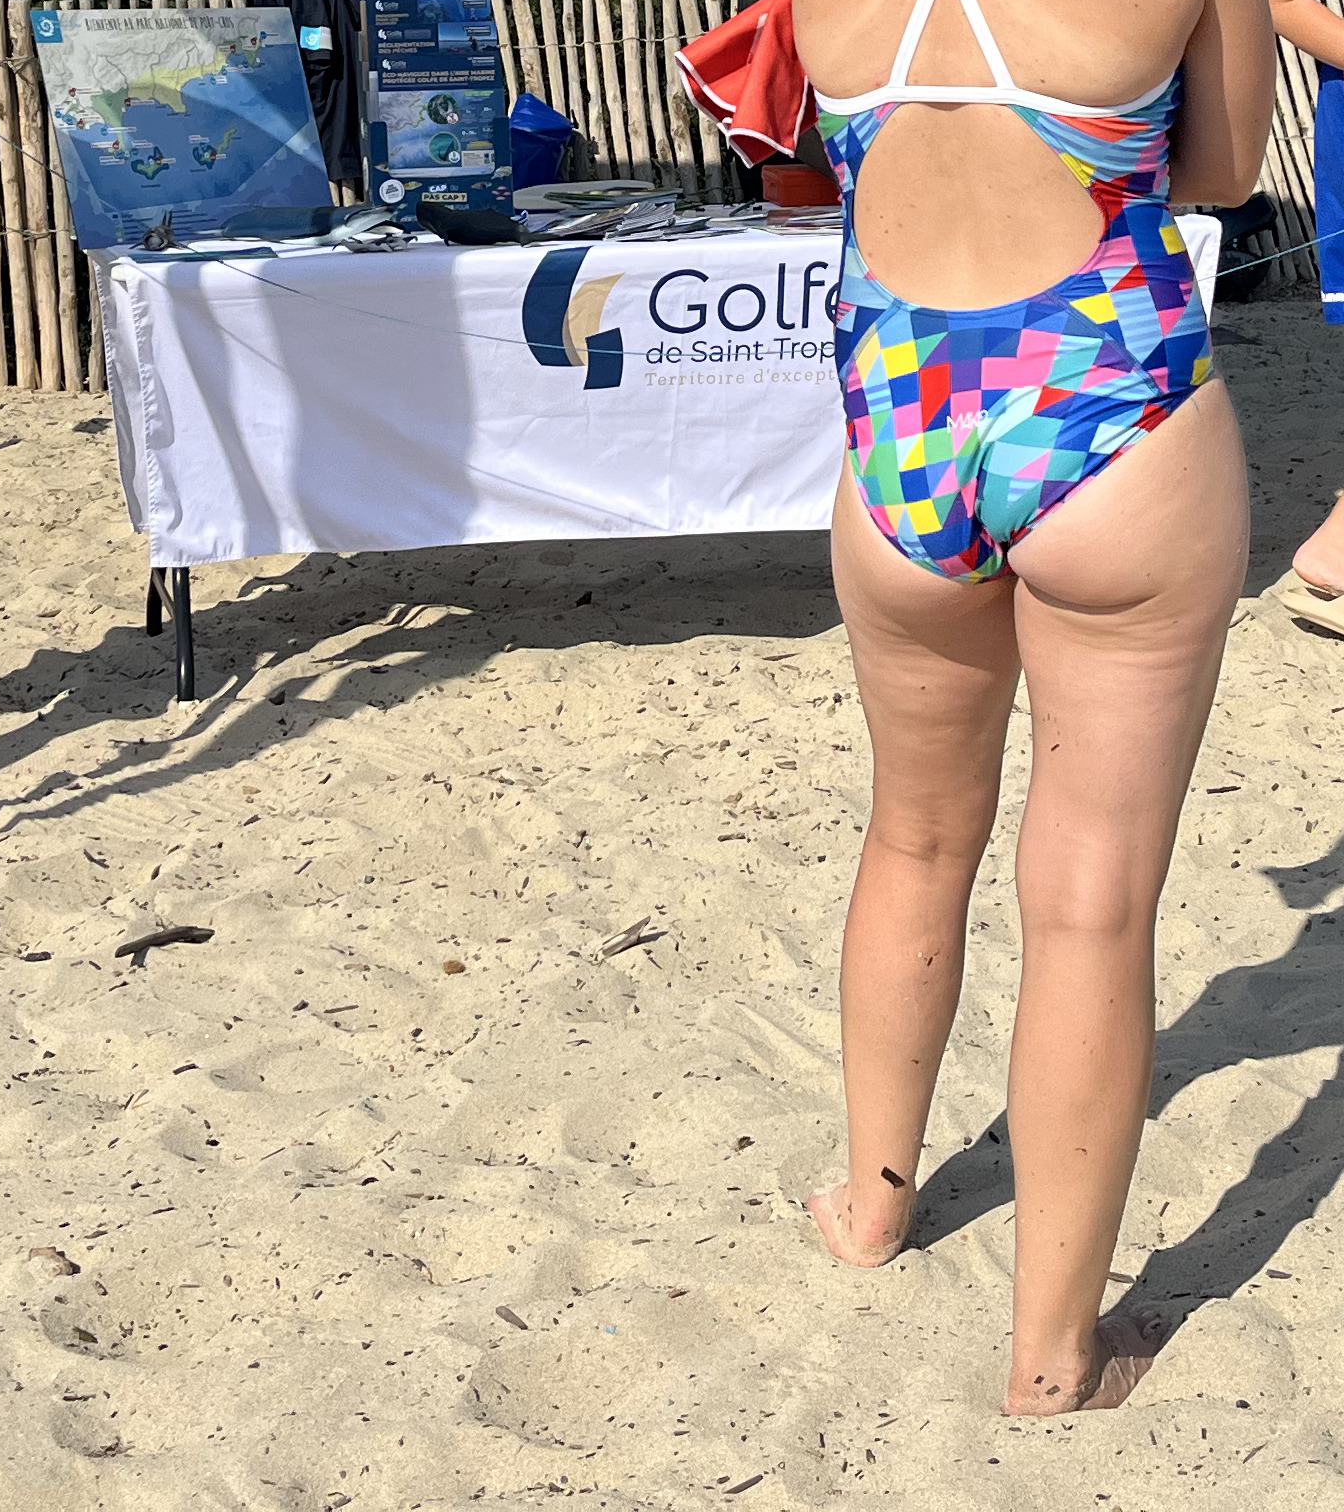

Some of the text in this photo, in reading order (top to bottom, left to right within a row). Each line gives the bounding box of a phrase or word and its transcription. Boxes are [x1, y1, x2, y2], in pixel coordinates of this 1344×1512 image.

[429, 184, 447, 193] CAP
[645, 342, 682, 364] de
[644, 368, 838, 386] Territoire d'except
